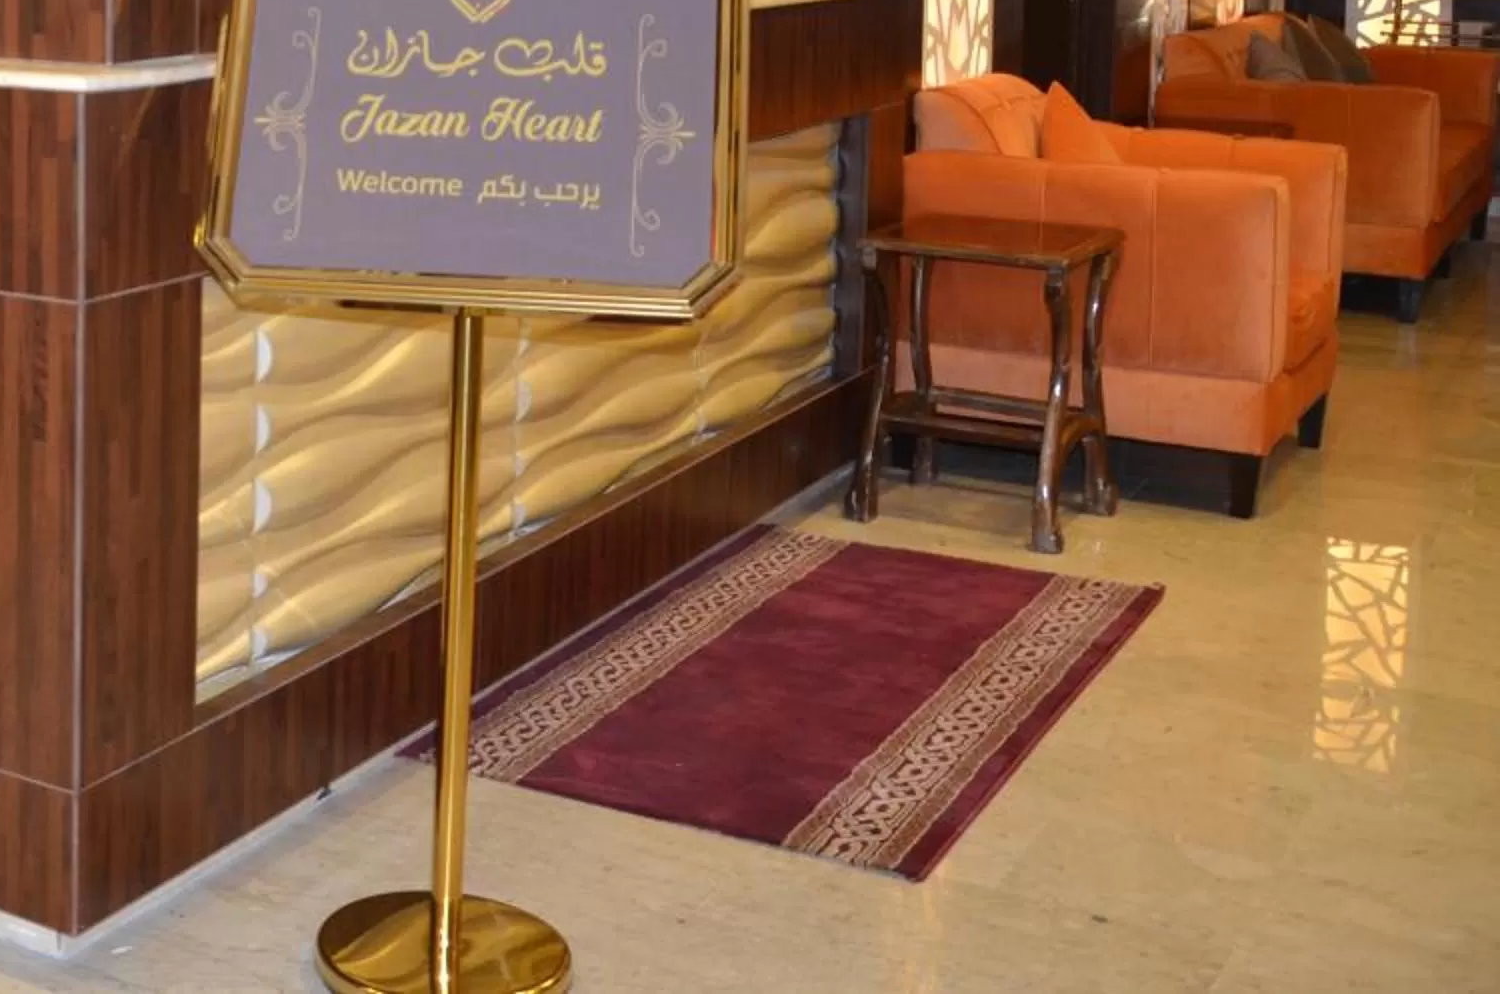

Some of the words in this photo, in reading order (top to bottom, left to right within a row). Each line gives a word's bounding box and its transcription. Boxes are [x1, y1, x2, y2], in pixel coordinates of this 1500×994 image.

[346, 26, 486, 78] جازان
[493, 30, 608, 82] قلب
[340, 93, 471, 143] Jazan
[481, 96, 605, 143] Heart
[336, 167, 464, 197] Welcome
[476, 174, 528, 207] بكم
[534, 180, 601, 210] يرحب
